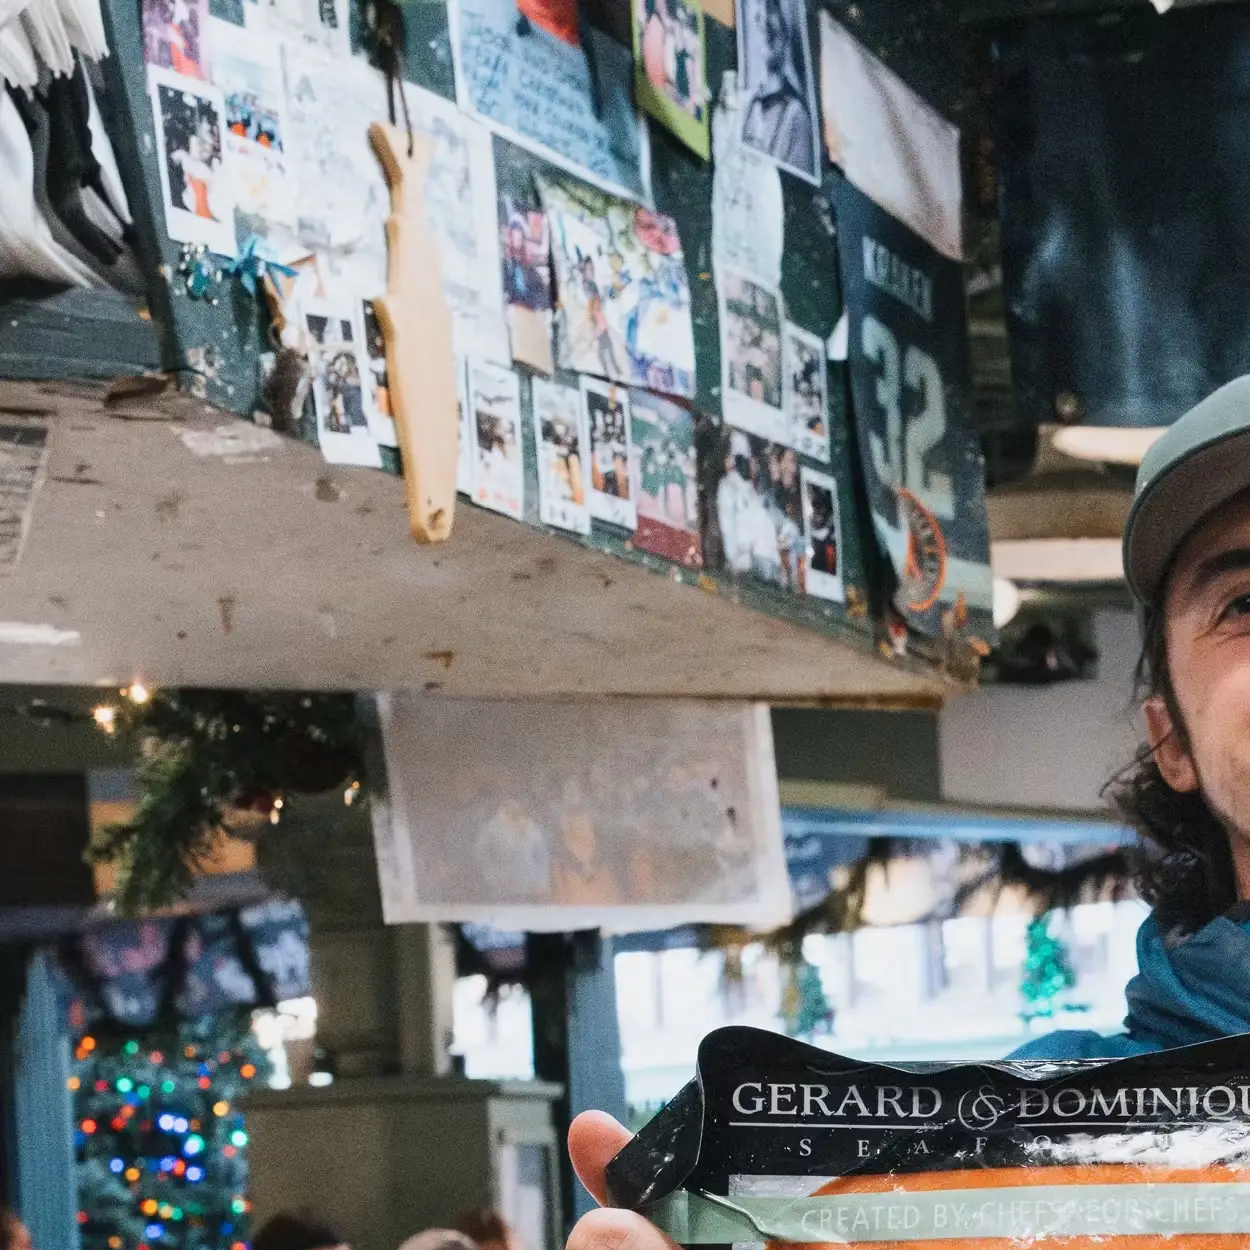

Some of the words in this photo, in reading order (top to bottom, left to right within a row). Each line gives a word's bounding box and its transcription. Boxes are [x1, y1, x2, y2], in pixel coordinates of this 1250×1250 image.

[731, 1082, 943, 1119] GERARD
[958, 1084, 1005, 1132] &
[802, 1205, 921, 1233] CREATED
[933, 1202, 967, 1228] BY
[1154, 1196, 1239, 1223] CHEFS
